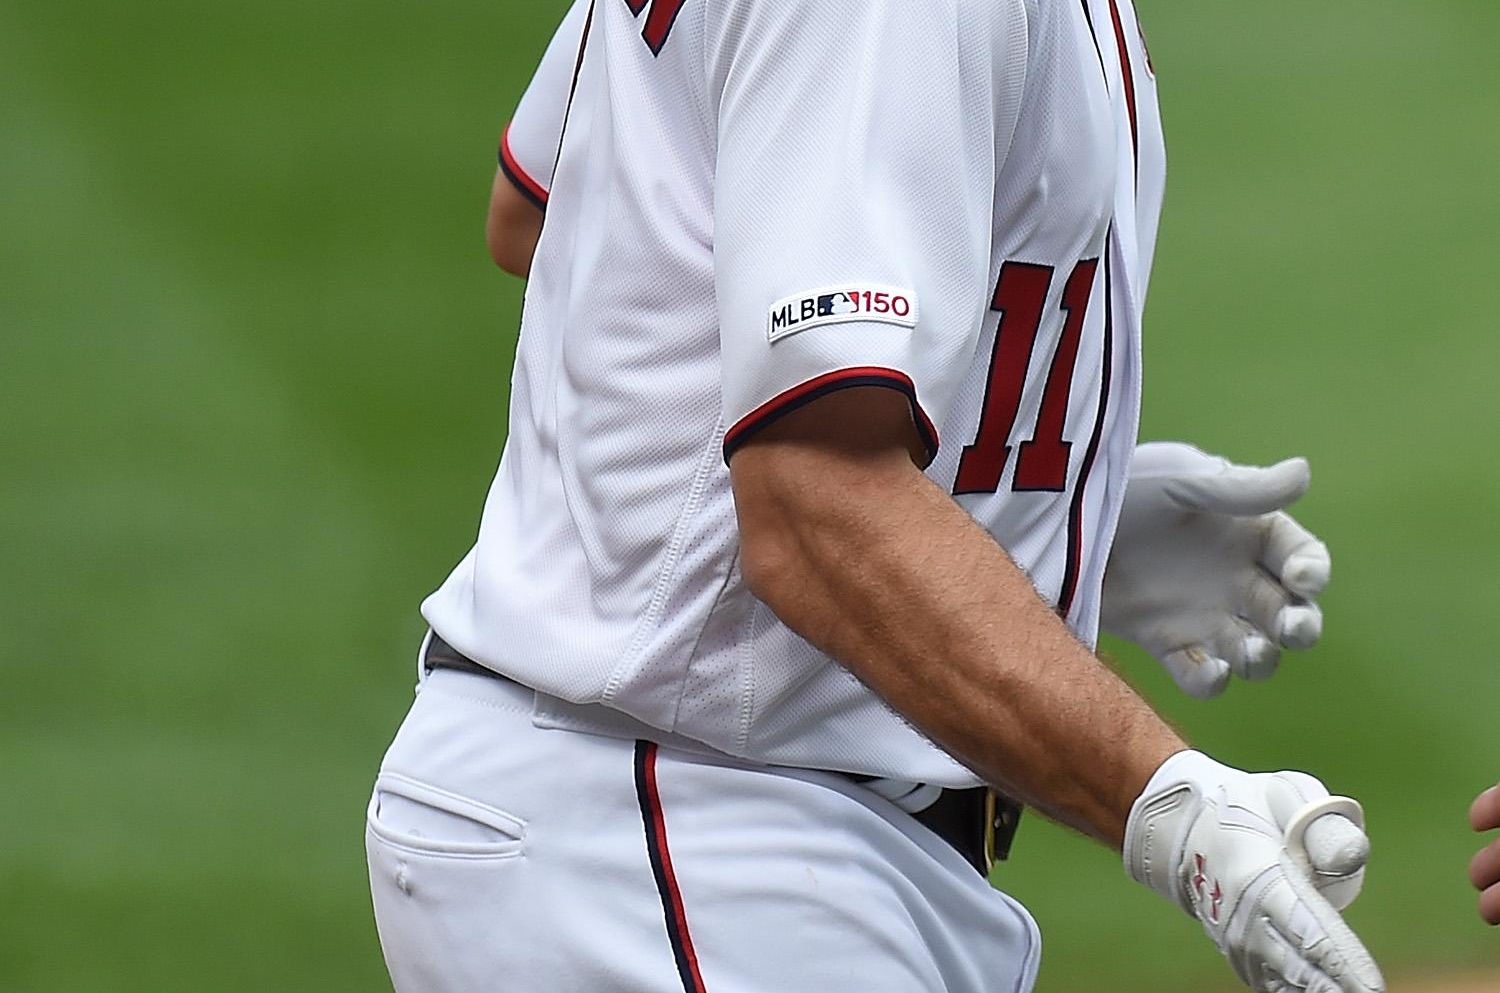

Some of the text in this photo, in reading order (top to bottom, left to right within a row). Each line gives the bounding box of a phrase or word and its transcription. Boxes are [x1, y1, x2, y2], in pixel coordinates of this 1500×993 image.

[771, 290, 910, 333] MLB 150
[952, 256, 1100, 496] 11
